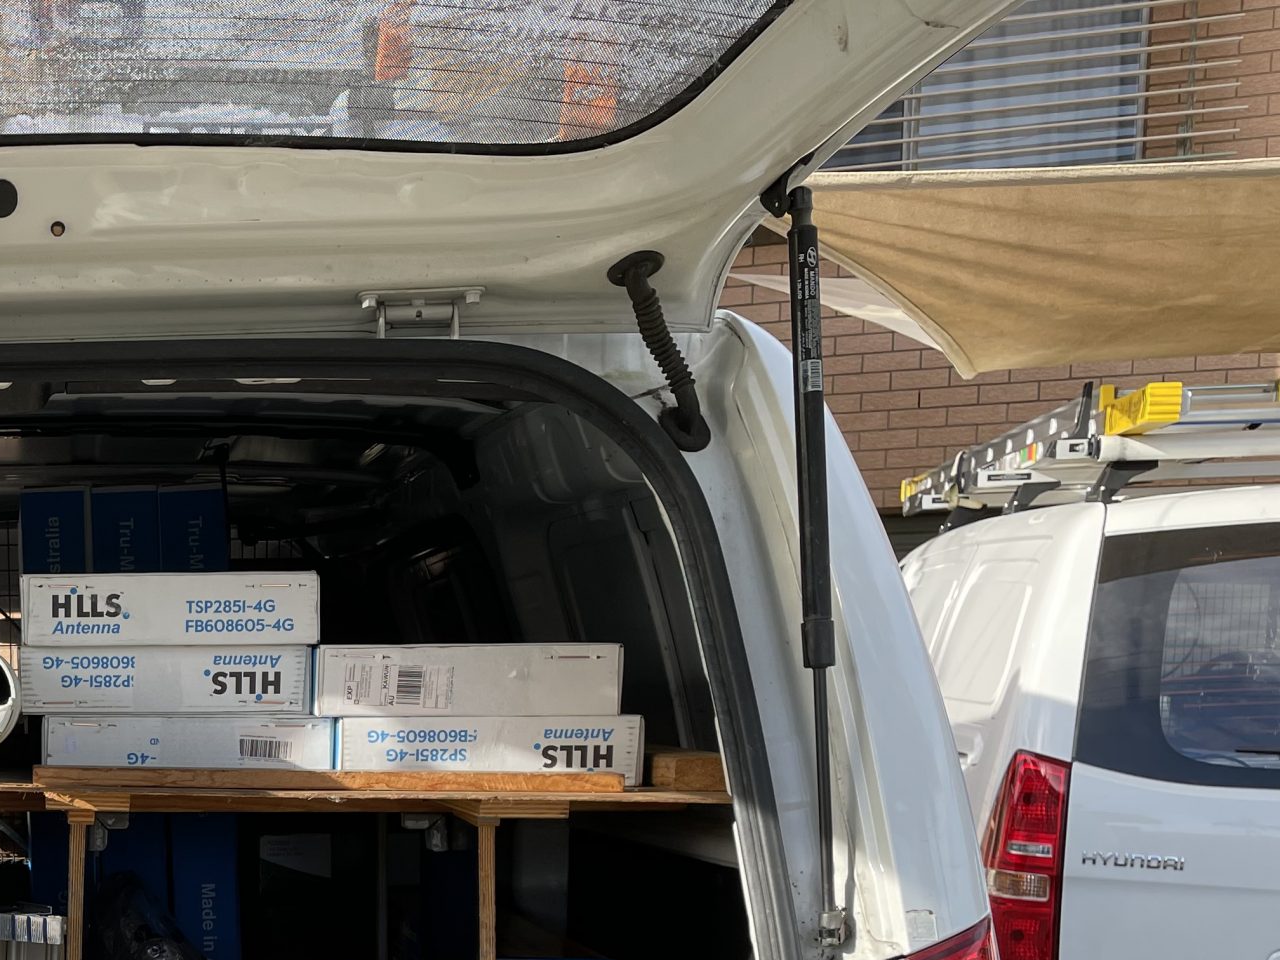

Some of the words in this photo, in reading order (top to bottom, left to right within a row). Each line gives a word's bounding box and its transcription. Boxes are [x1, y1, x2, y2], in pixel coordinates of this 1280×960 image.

[52, 621, 121, 636] Antenna
[185, 618, 295, 633] FB608605-4G
[213, 655, 282, 669] Antenna
[544, 728, 614, 742] Antenna
[1081, 850, 1185, 871] HYUNDAI
[201, 882, 216, 931] Made
[203, 936, 215, 952] in
